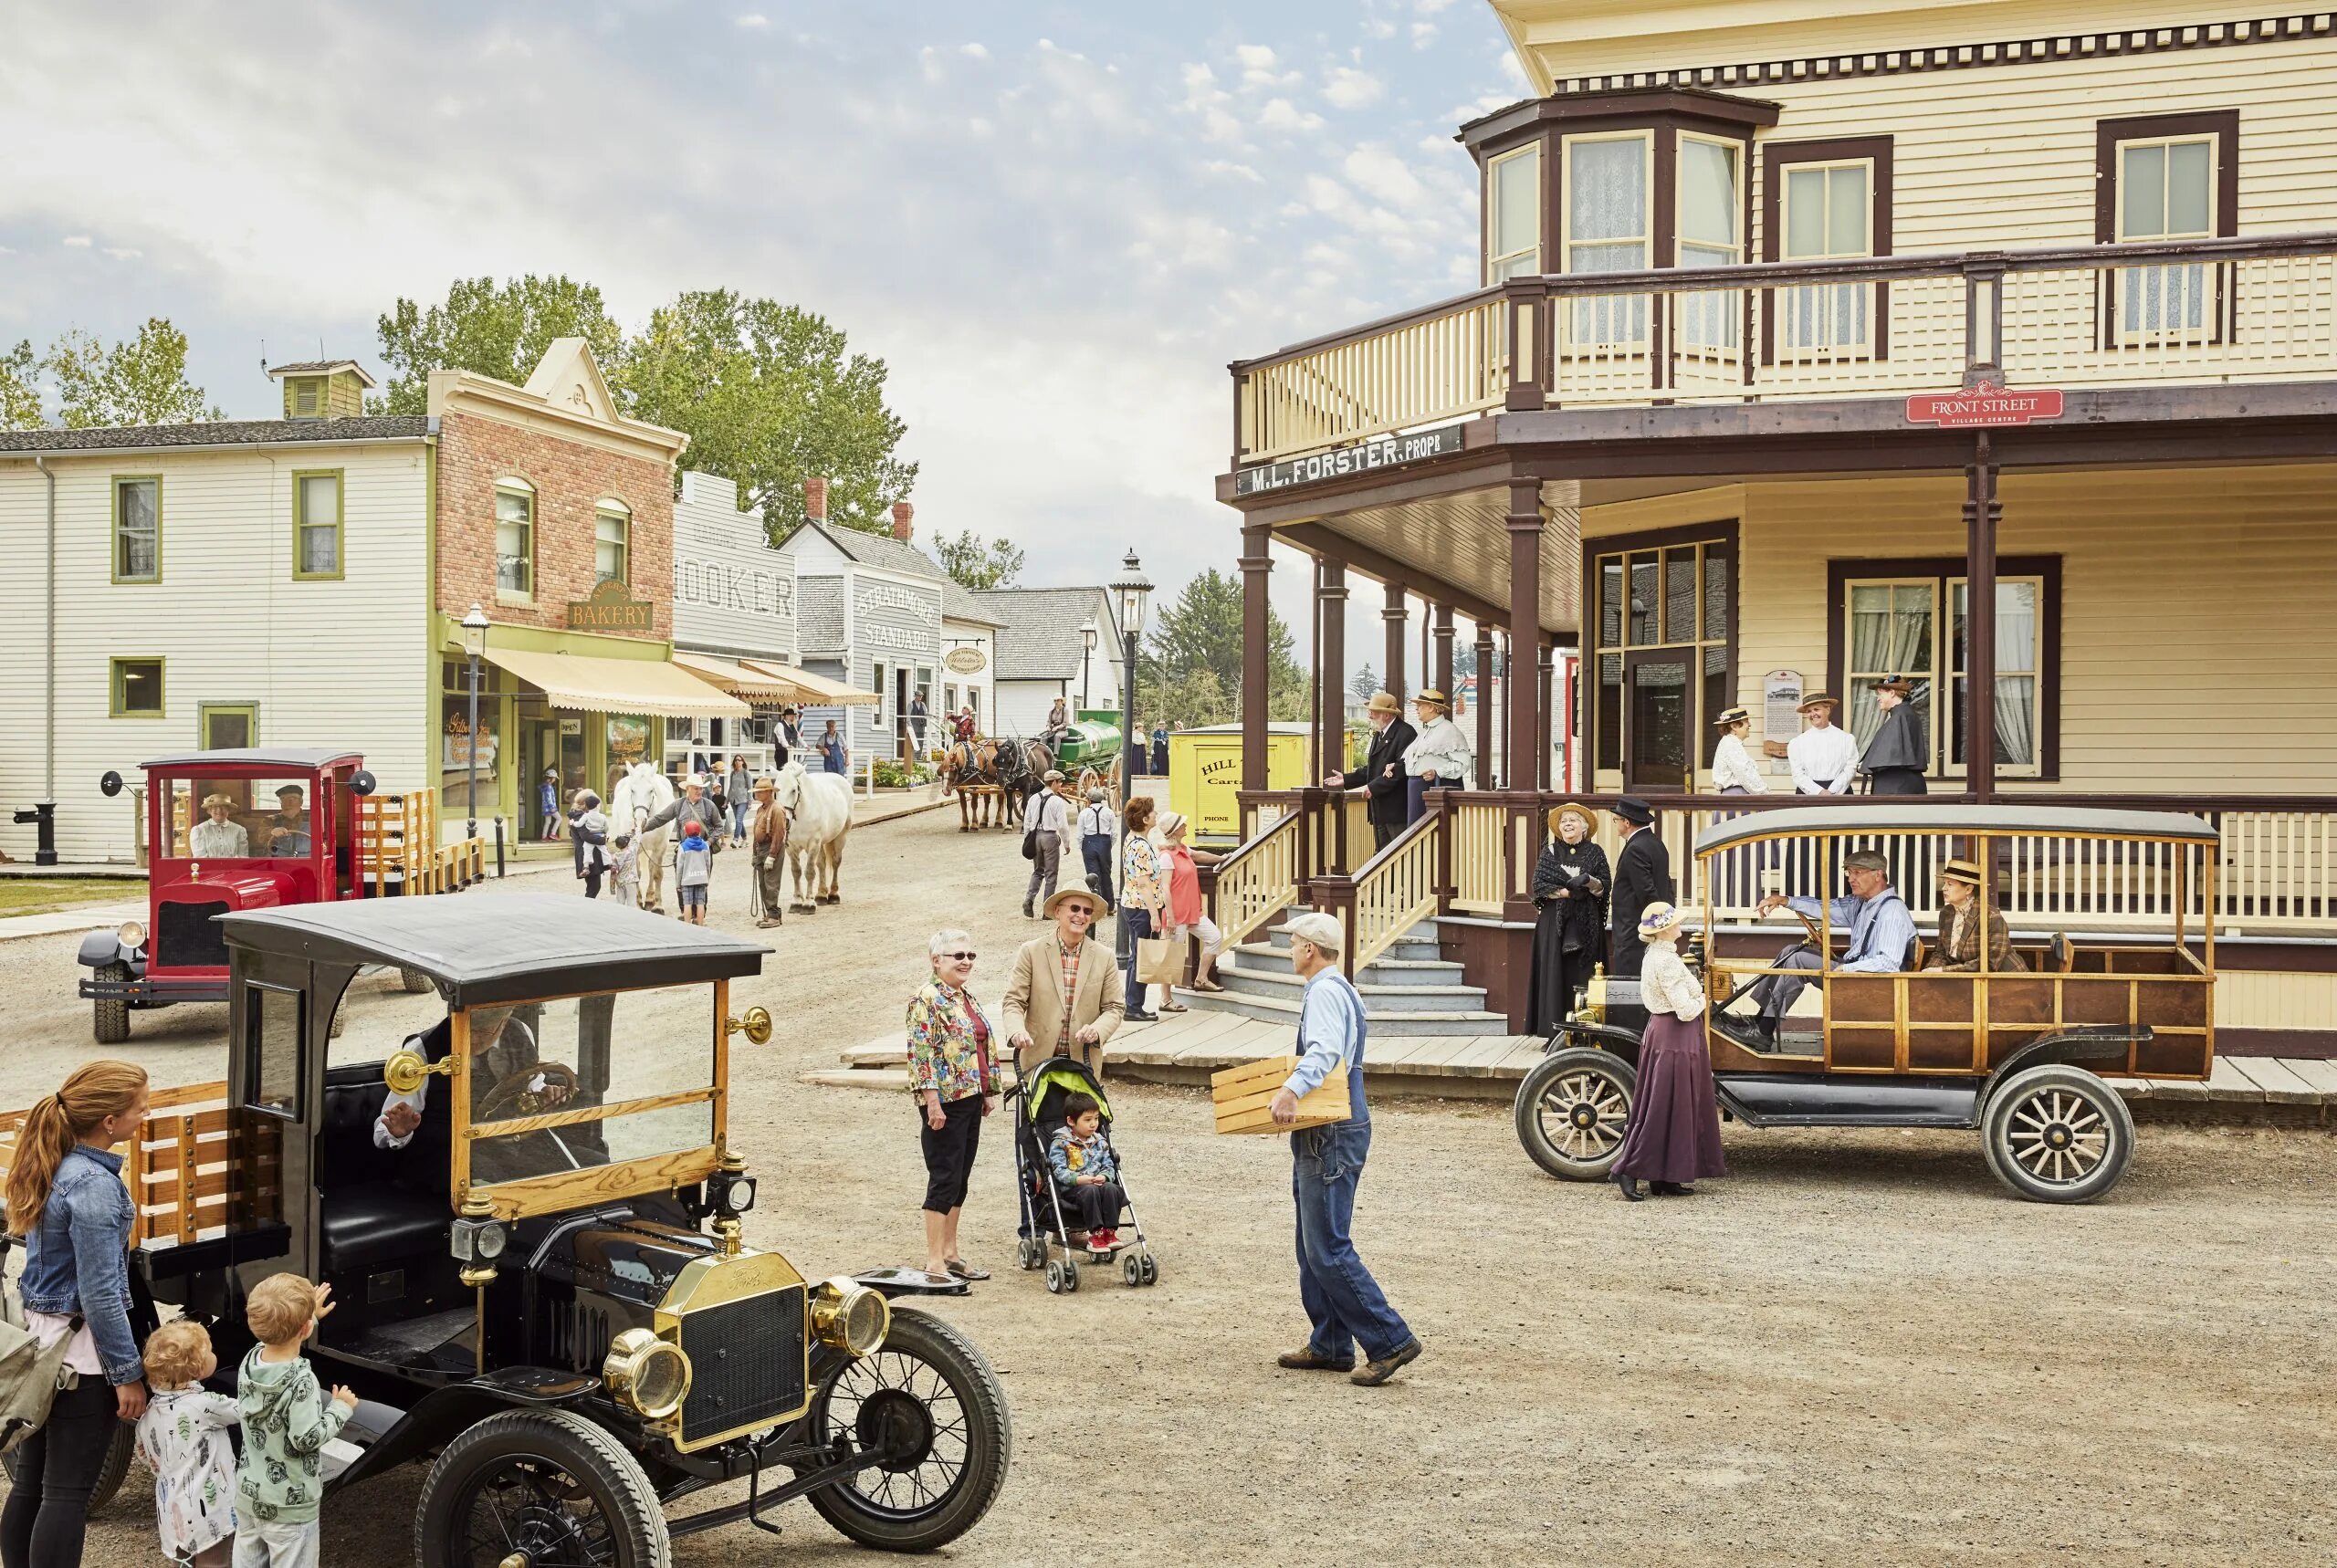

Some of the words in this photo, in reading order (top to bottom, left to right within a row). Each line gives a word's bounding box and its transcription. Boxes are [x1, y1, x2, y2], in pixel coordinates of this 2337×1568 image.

[1932, 401, 1979, 416] FRONT
[1983, 398, 2038, 413] STREET
[592, 581, 629, 601] ALBERTA
[573, 605, 650, 625] BAKERY
[858, 585, 935, 628] STRATHMORE
[865, 623, 929, 651] STANDARD
[561, 723, 578, 731] OPEN
[1201, 758, 1236, 776] HILL
